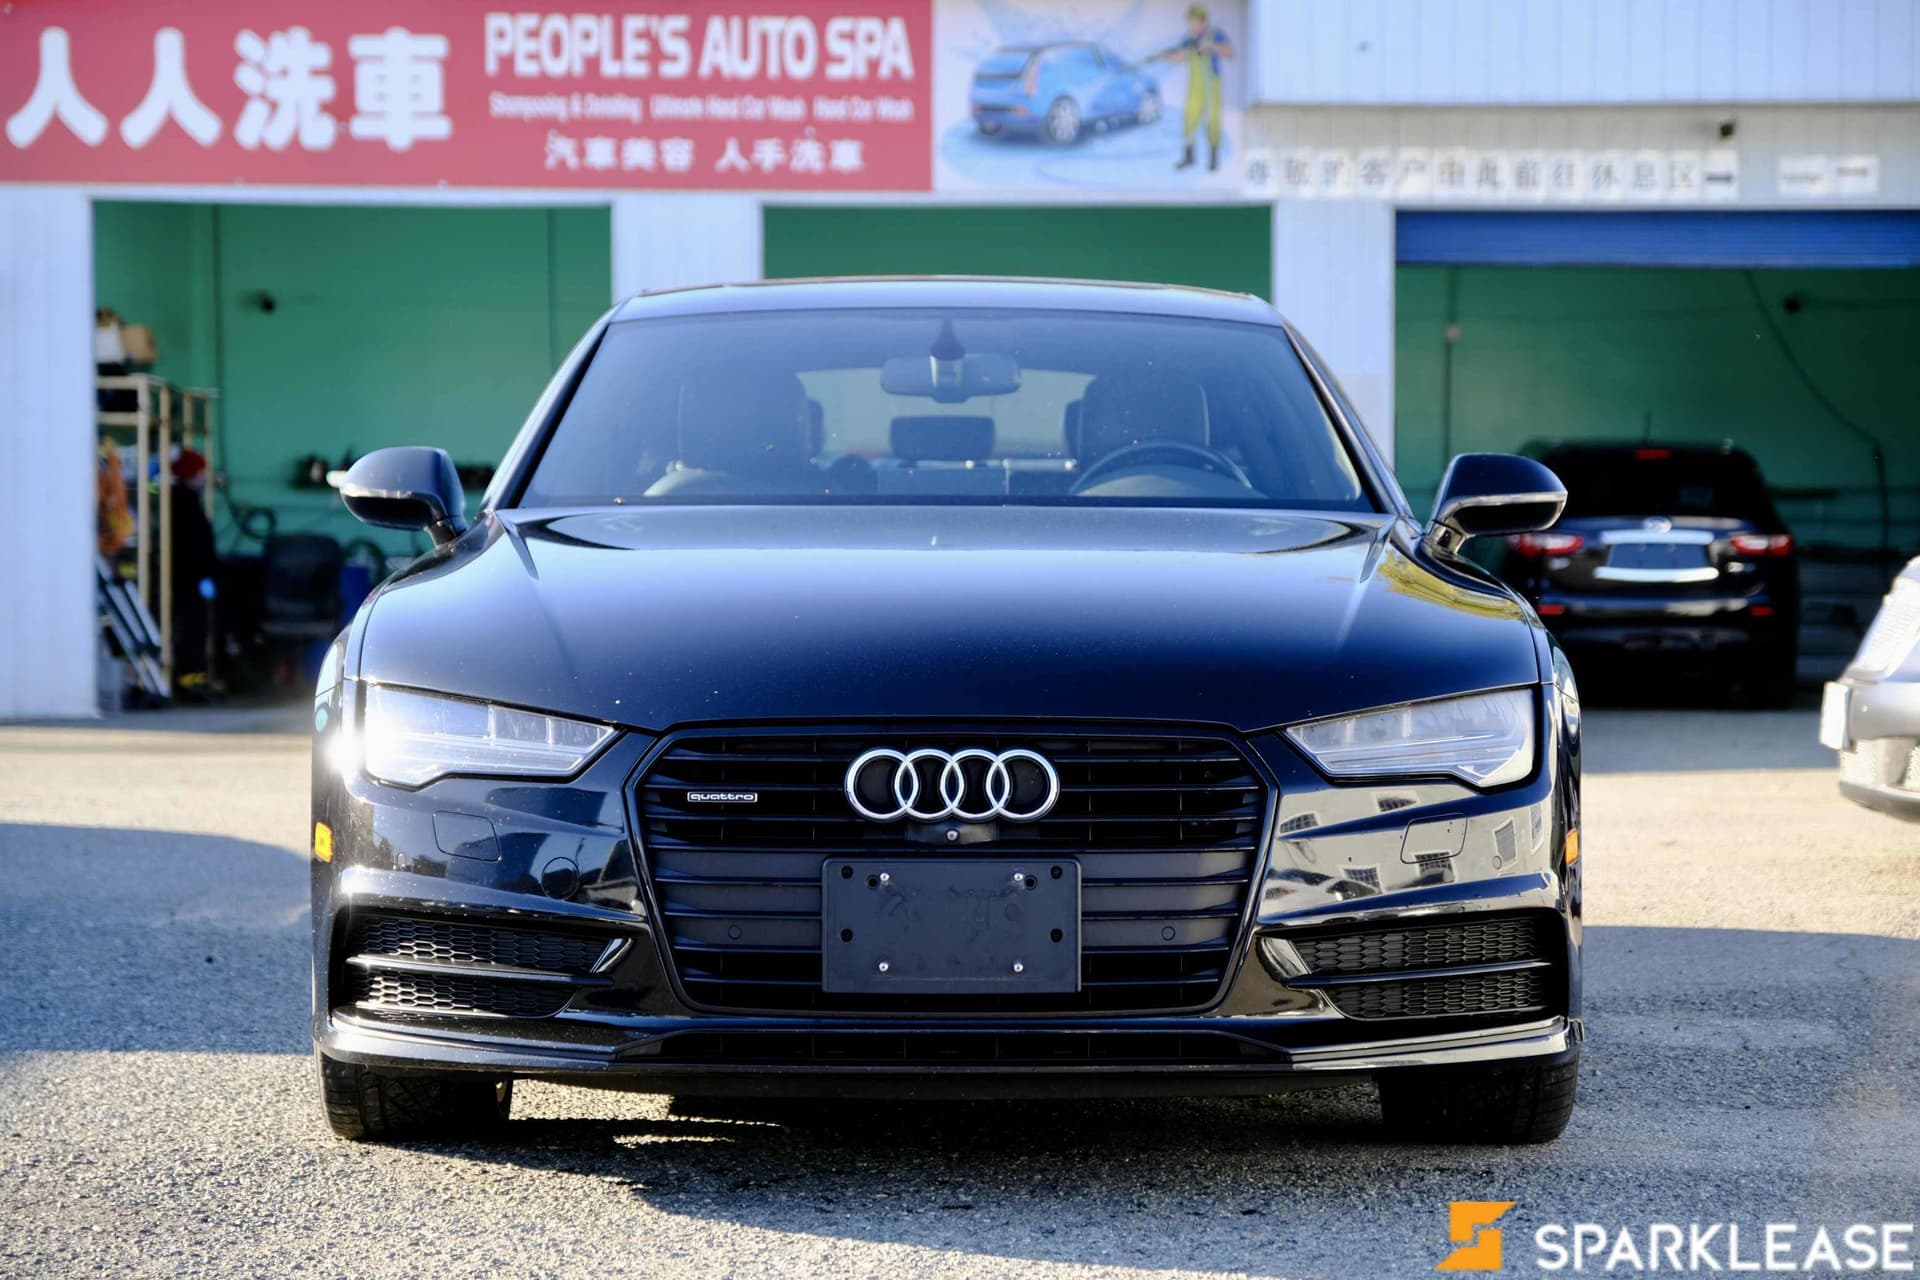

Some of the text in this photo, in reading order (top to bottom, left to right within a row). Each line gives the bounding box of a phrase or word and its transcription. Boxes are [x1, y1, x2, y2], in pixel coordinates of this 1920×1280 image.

[484, 12, 915, 80] PEOPLE'S AUTO SPA
[5, 26, 453, 151] 人人洗車
[545, 131, 865, 172] 汽車美容 人手洗車
[690, 793, 754, 801] quattro
